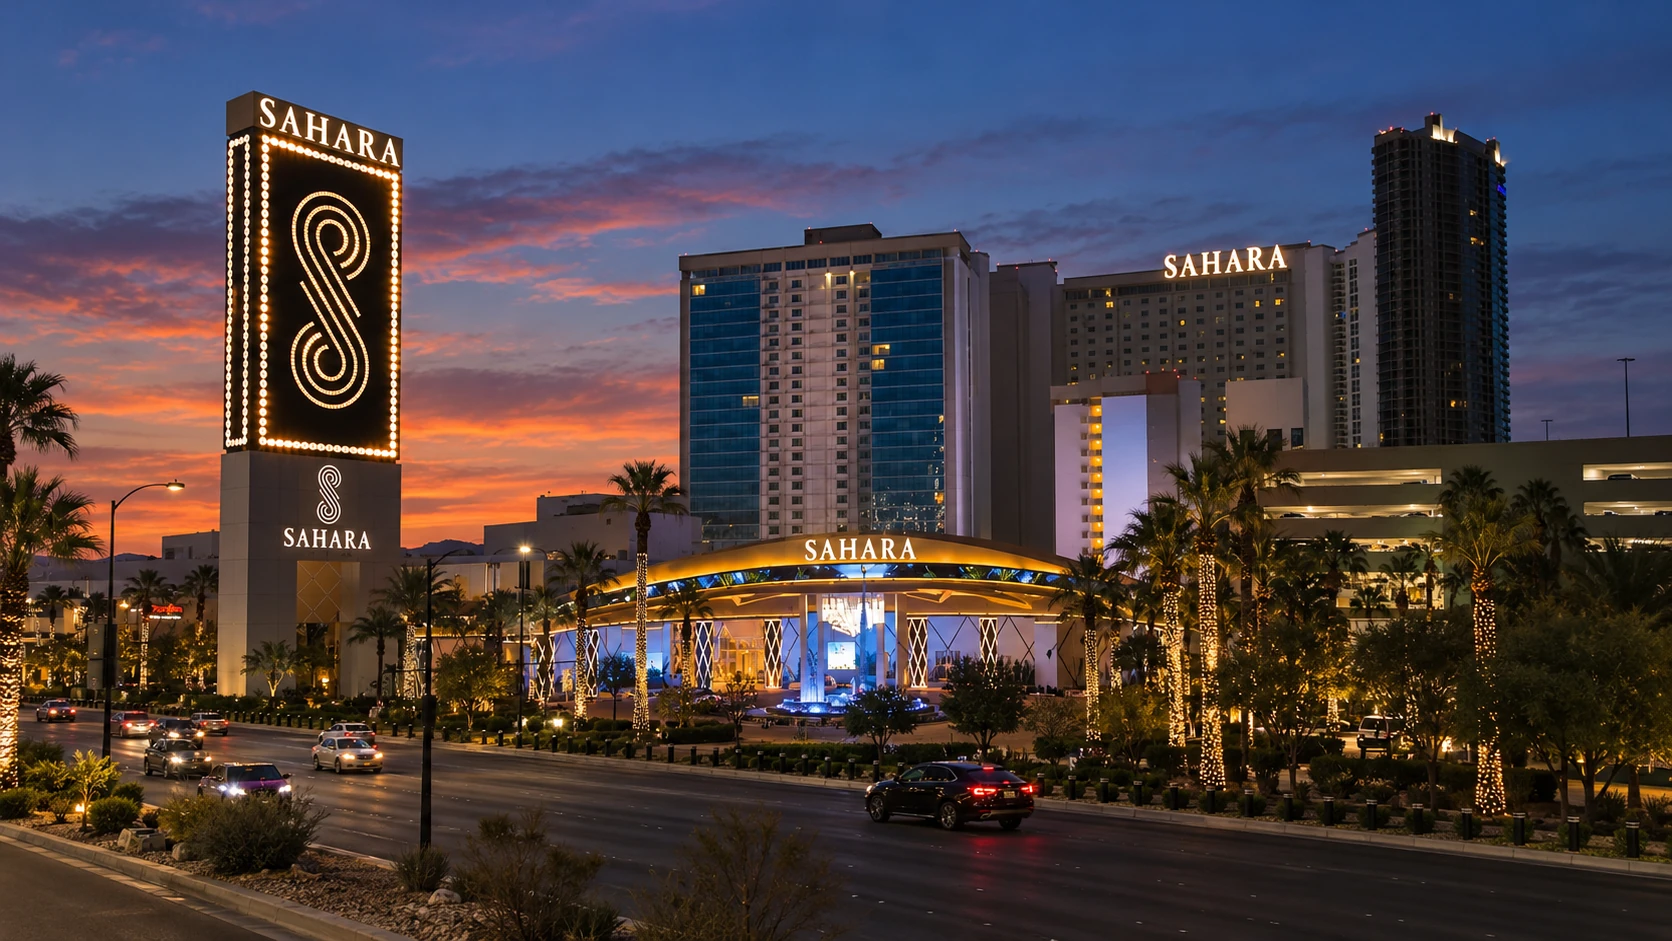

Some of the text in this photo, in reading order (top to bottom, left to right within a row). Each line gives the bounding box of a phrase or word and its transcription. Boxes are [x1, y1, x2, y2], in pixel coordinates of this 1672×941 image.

[259, 97, 400, 168] SAHARA
[1164, 243, 1288, 279] SAHARA
[283, 527, 372, 550] SAHARA
[804, 537, 917, 561] SAHARA
